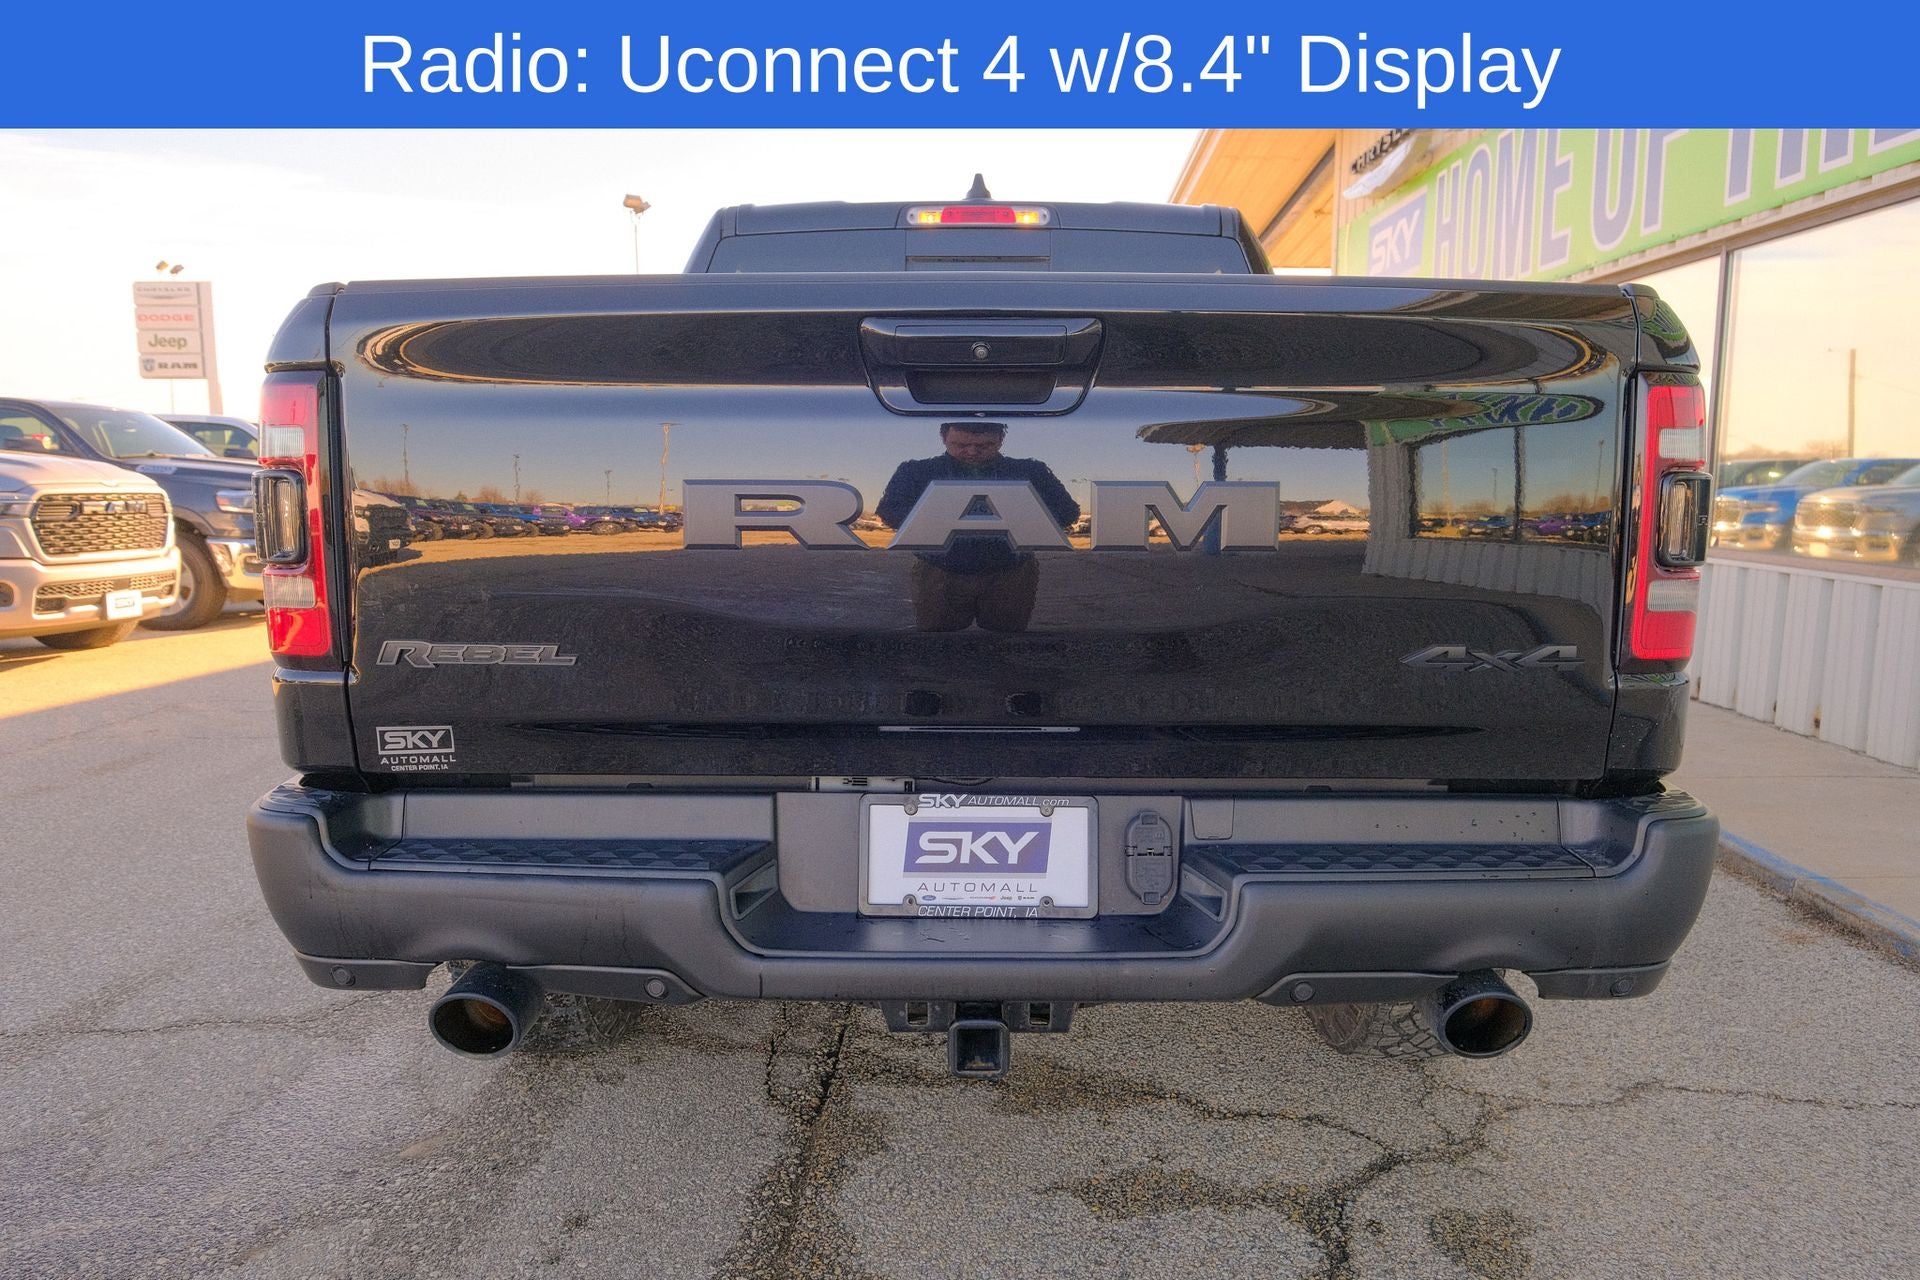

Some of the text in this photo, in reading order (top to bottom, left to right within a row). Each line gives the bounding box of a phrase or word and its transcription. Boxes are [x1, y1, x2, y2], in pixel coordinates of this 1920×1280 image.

[1432, 128, 1574, 281] HOME
[1369, 208, 1421, 276] SKY
[148, 333, 188, 350] Jeep
[683, 479, 1280, 551] RAM
[376, 640, 579, 668] REBEL
[384, 730, 447, 749] SKY
[380, 755, 457, 764] AUTOMALL
[918, 793, 968, 808] SKY
[915, 831, 1040, 865] SKY
[917, 882, 1038, 892] AUTOMALL
[918, 905, 1038, 918] CENTER POINT, IA
